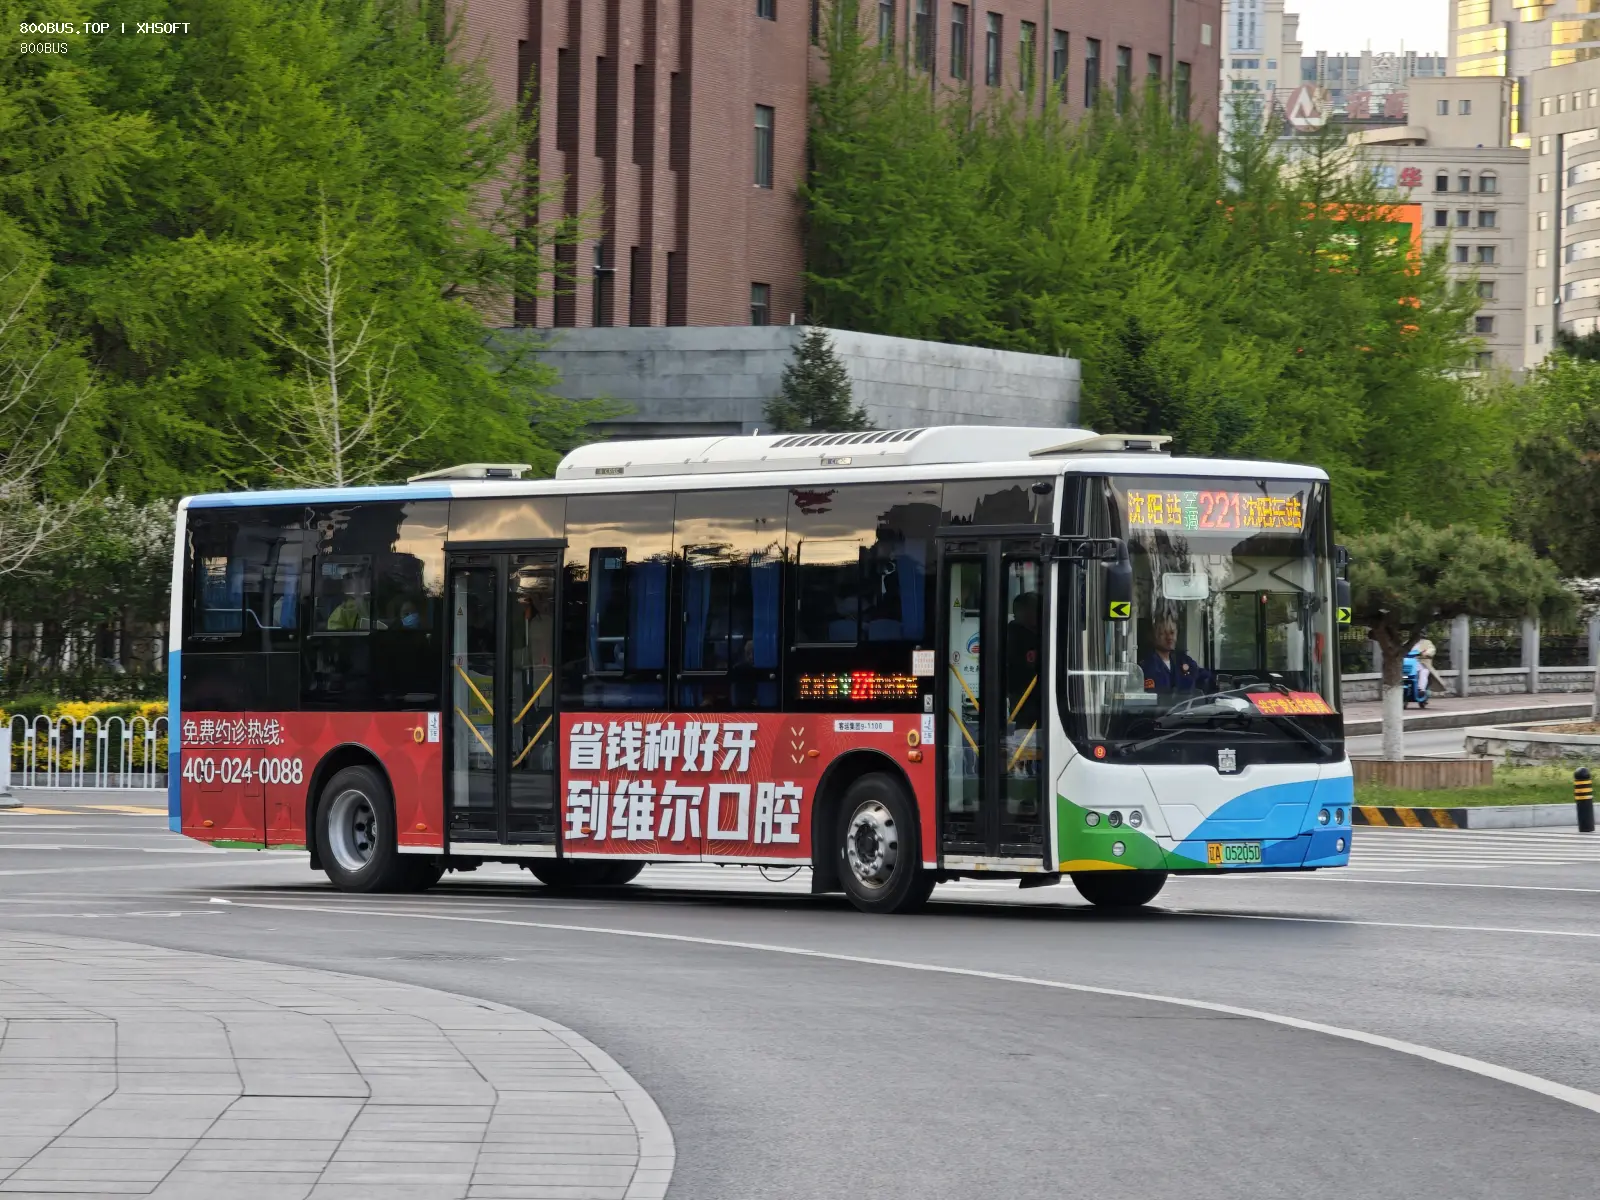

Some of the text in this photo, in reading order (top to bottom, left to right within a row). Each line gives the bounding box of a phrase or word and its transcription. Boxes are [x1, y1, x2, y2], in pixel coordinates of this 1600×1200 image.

[1128, 490, 1302, 531] 沈阳站 空调 221 沈阳东站
[569, 721, 758, 772] 省钱种好牙
[182, 757, 303, 785] 400-024-0088
[565, 779, 804, 844] 到维尔口腔
